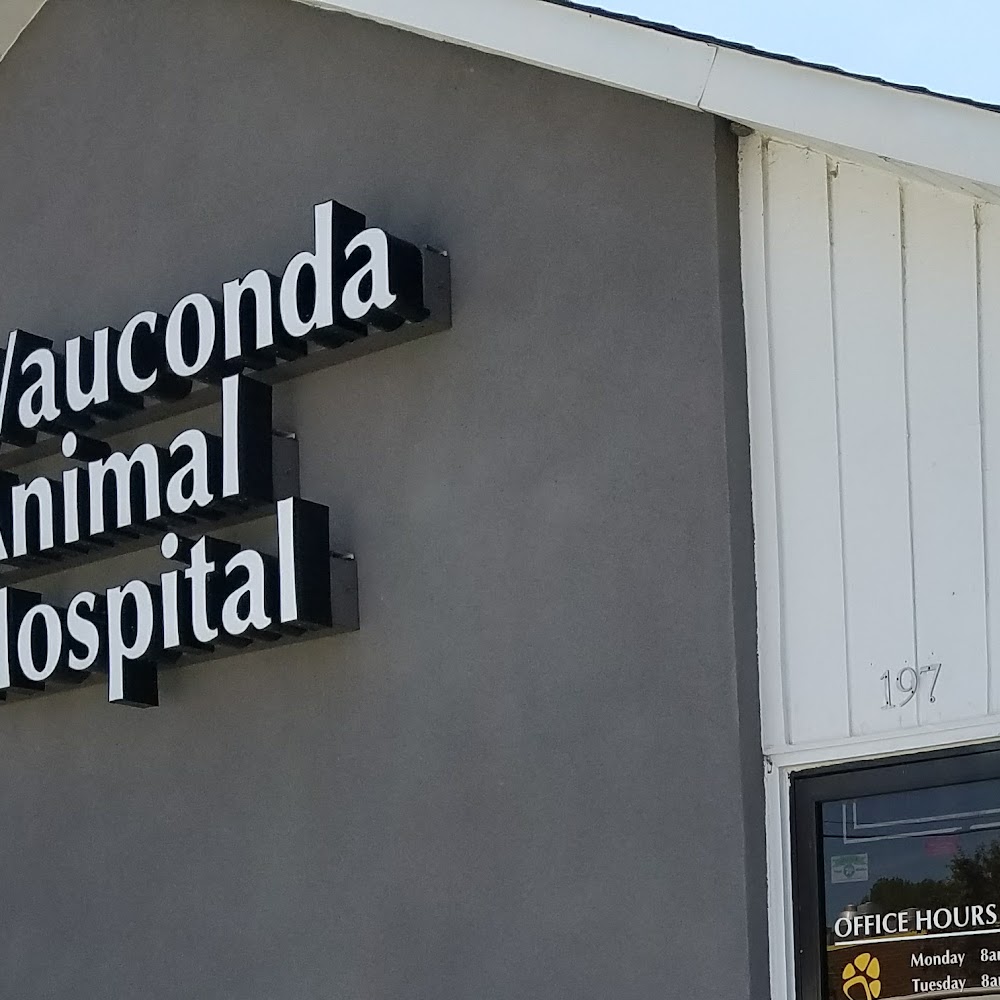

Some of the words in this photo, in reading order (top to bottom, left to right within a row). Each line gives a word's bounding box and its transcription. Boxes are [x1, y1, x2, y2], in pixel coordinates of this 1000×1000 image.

[880, 663, 942, 709] 197
[834, 911, 908, 938] OFFICE
[915, 903, 998, 931] HOURS
[910, 949, 966, 967] Monday
[911, 977, 967, 994] Tuesday
